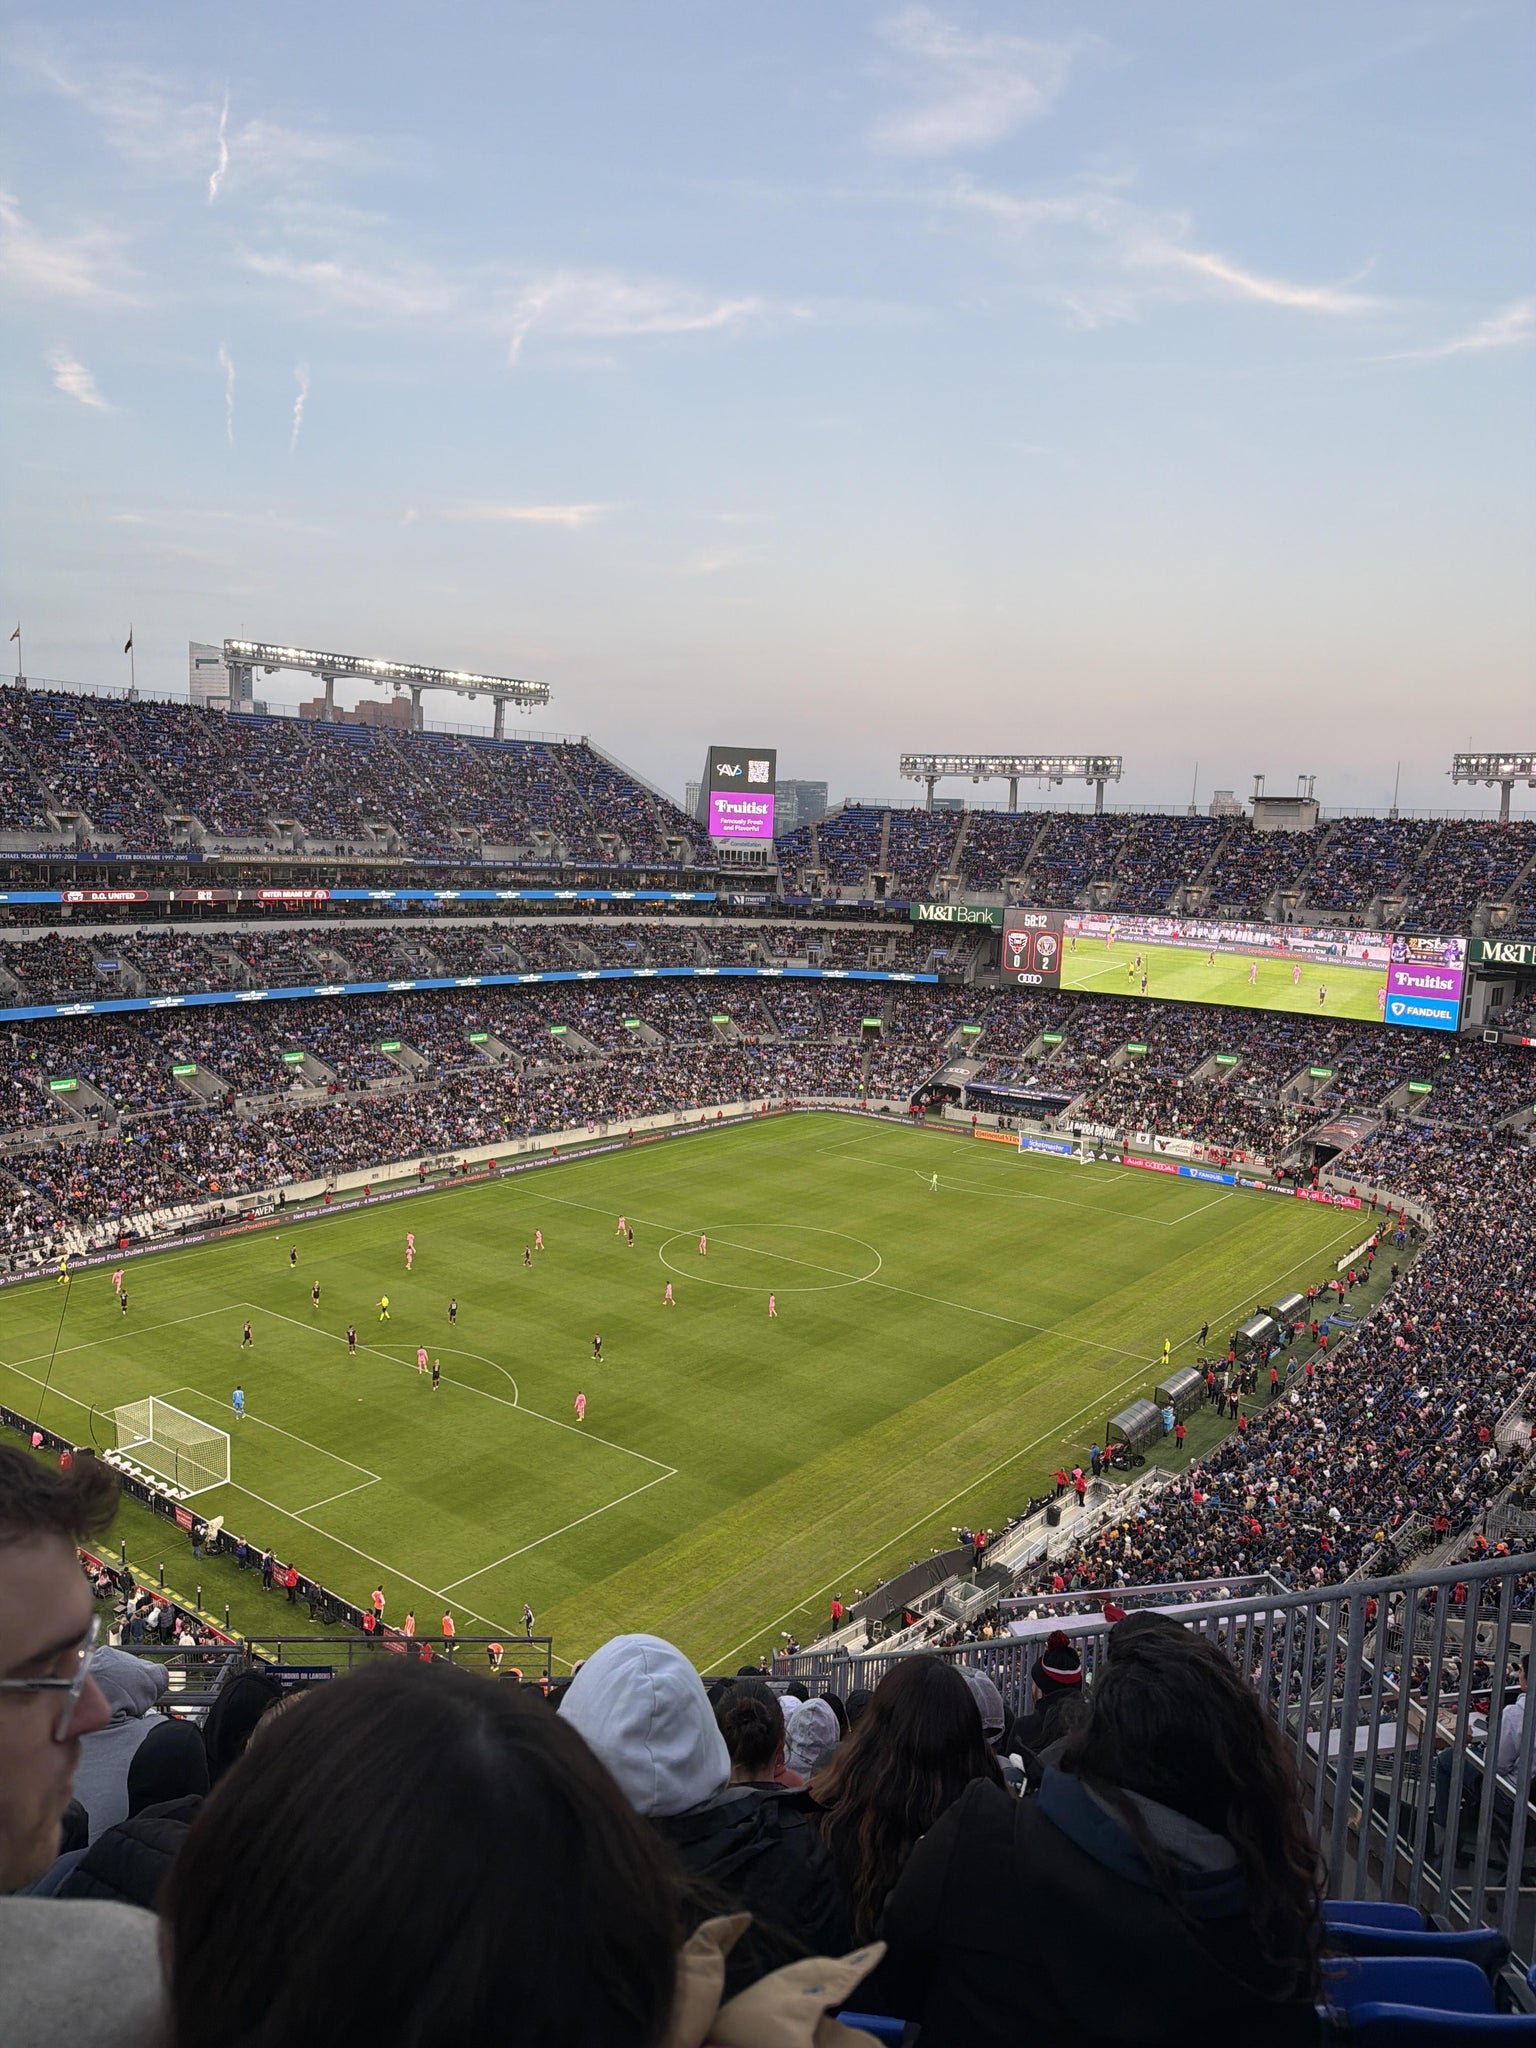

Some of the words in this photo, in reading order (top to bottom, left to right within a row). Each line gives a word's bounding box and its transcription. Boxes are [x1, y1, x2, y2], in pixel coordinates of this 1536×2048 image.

[715, 800, 769, 814] Fruitist
[237, 890, 243, 900] 2
[918, 904, 957, 921] M&T
[957, 906, 994, 923] Bank
[1024, 914, 1047, 928] 58:12
[1481, 941, 1531, 963] M&T
[1013, 954, 1020, 967] 0
[1042, 957, 1049, 970] 2
[1328, 956, 1341, 964] Stop
[1342, 959, 1367, 967] Loudoun
[1368, 961, 1388, 969] County
[1394, 971, 1455, 990] Fruitist
[1406, 1006, 1452, 1019] FANDUEL
[976, 1129, 1005, 1140] Continental
[1066, 1120, 1074, 1131] LA
[1094, 1125, 1116, 1140] BRAVA
[1029, 1138, 1064, 1152] ticketmaster
[1126, 1158, 1143, 1166] Audi
[1198, 1171, 1224, 1181] FANDUEL
[1267, 1185, 1295, 1195] FITNESS
[293, 1212, 306, 1220] Next
[306, 1209, 318, 1219] Stop
[319, 1205, 341, 1216] Loudoun
[342, 1200, 360, 1212] County
[369, 1195, 379, 1203] New
[379, 1193, 392, 1201] Silver
[403, 1187, 417, 1196] Metro
[417, 1184, 435, 1193] Stations
[219, 1218, 280, 1237] LoudounPossible.com
[6, 1273, 23, 1282] Your
[24, 1270, 40, 1278] Next
[42, 1266, 60, 1276] Troph
[67, 1259, 87, 1269] Office
[88, 1255, 106, 1265] Steps
[107, 1252, 124, 1261] From
[124, 1247, 144, 1257] Dulles
[145, 1238, 184, 1252] International
[184, 1234, 205, 1245] Airport
